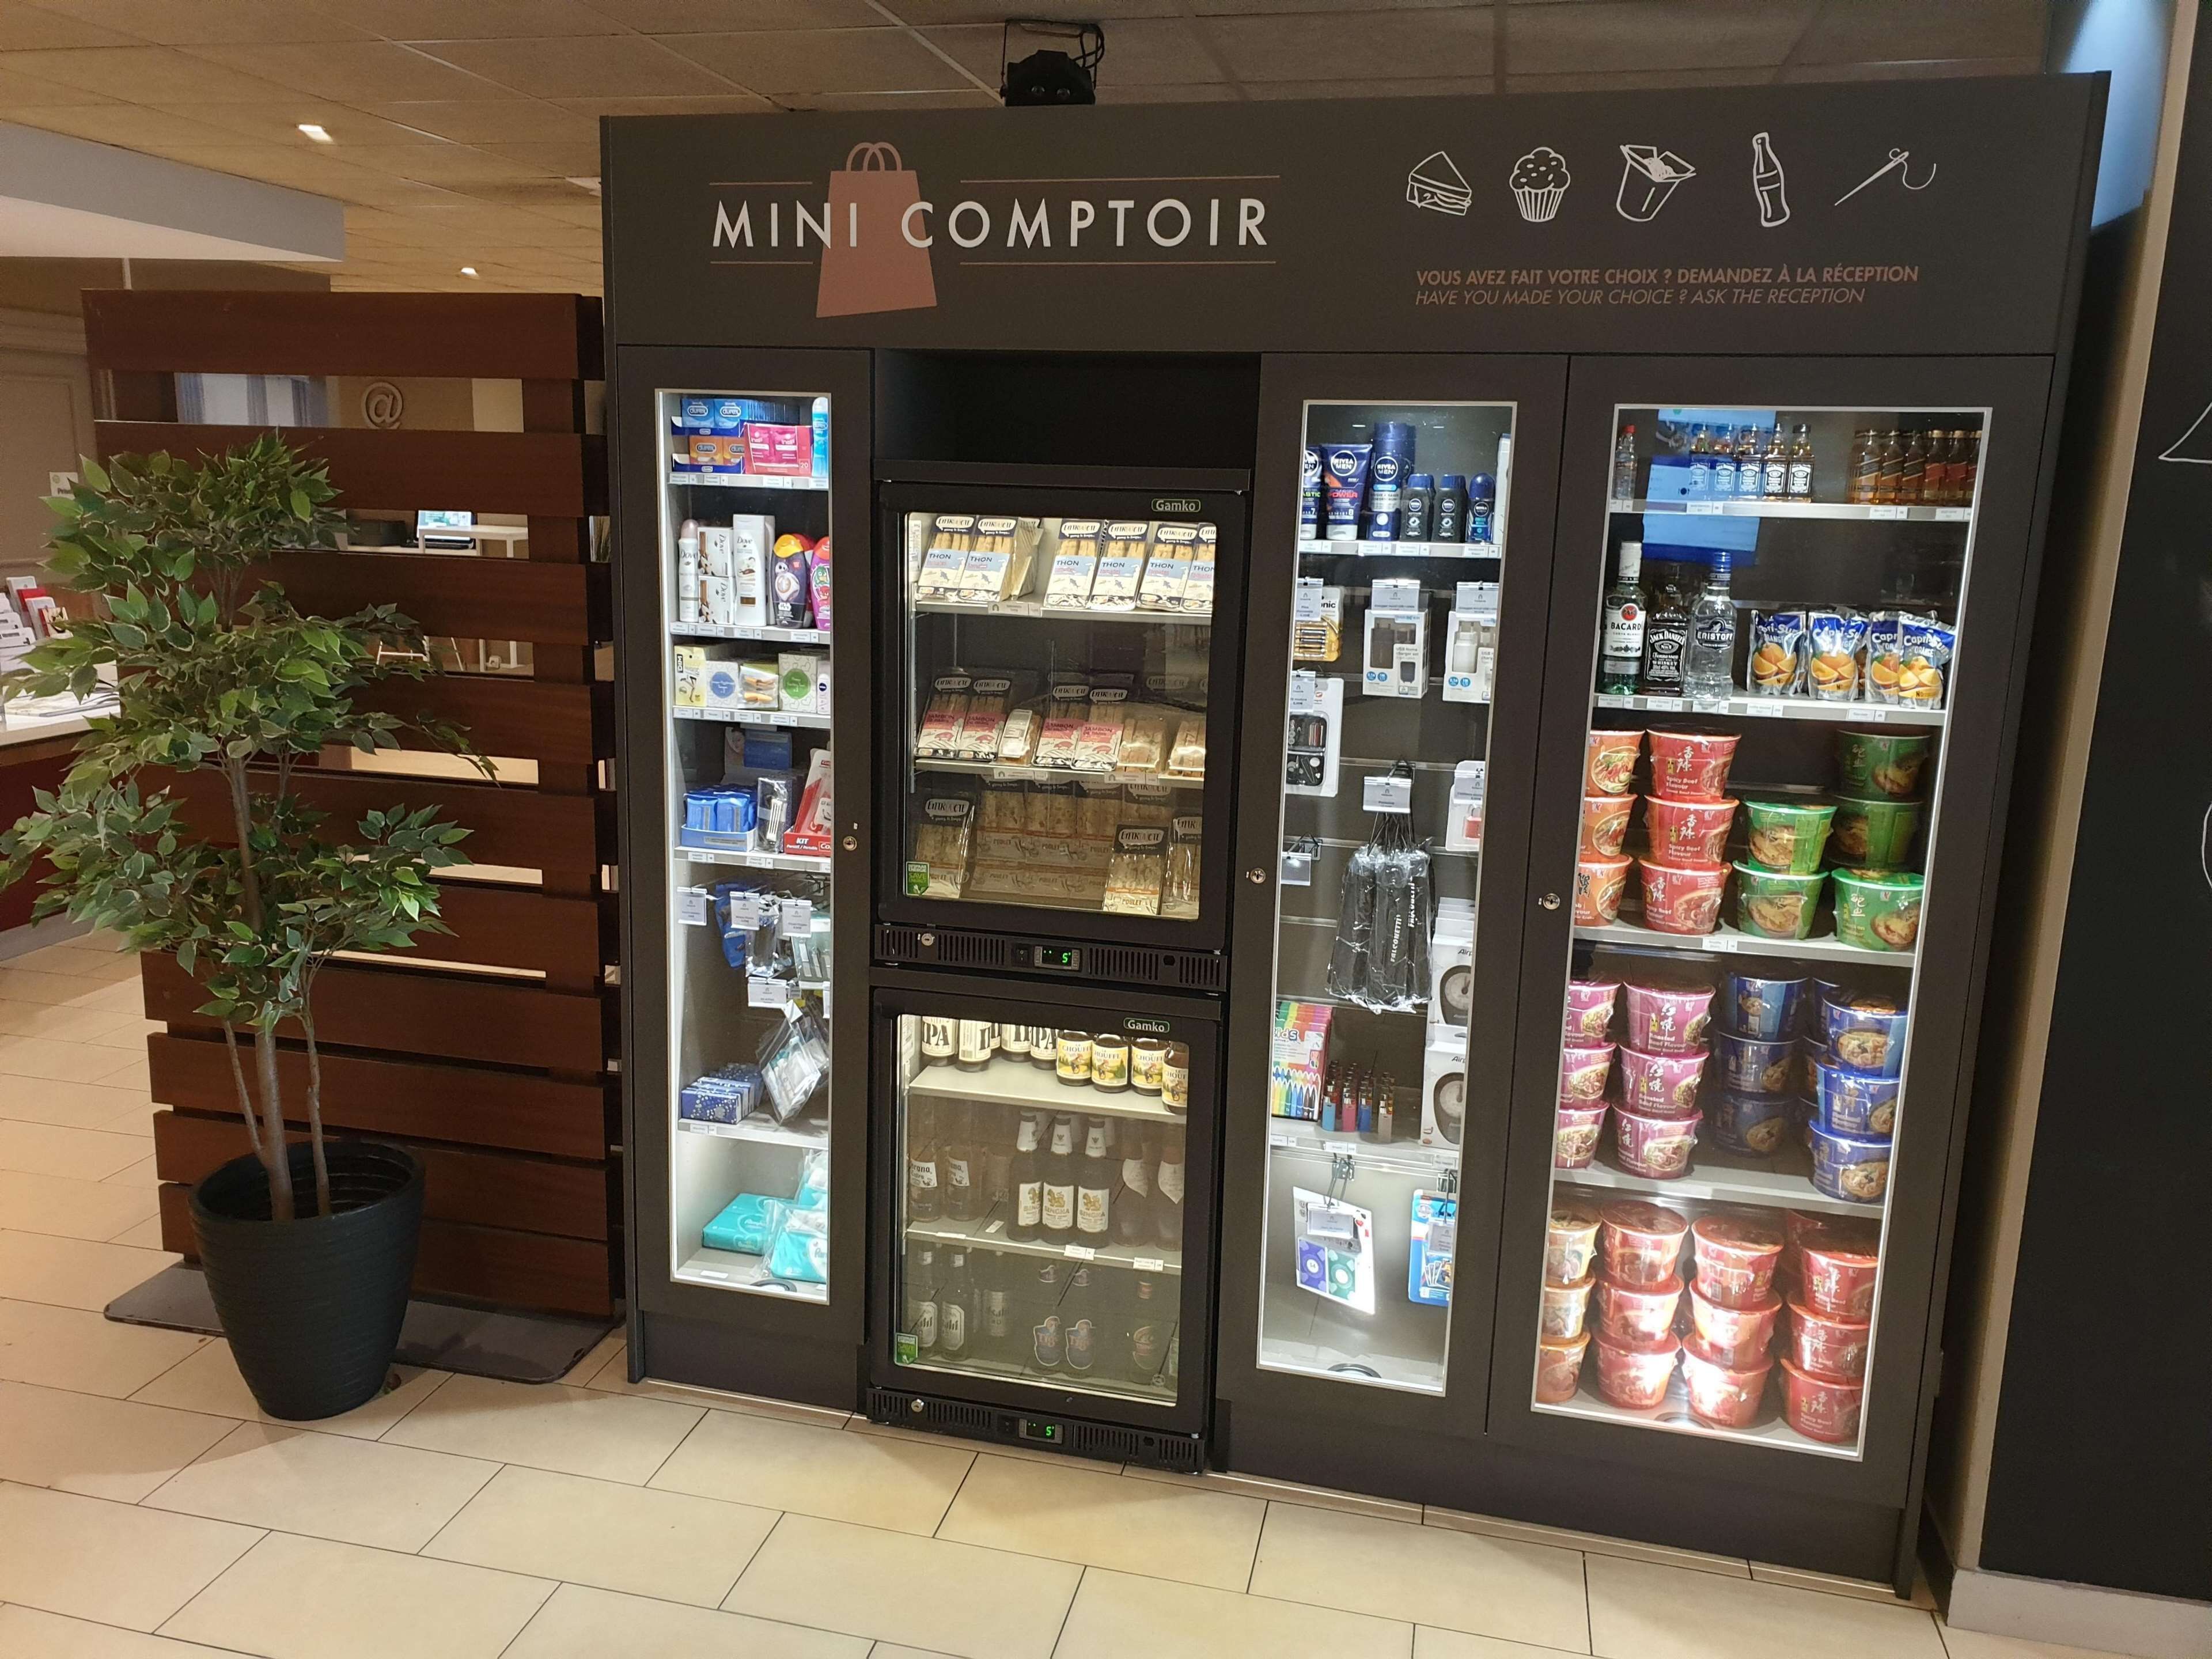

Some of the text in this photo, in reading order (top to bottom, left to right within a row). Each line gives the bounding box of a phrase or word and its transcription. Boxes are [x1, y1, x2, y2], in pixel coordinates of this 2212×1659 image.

[713, 198, 1267, 249] MINI COMPTOIR
[1416, 263, 1919, 286] VOUS AVEZ FAIT VOTRE CHOIX ? DEMANDEZ À LA RÉCEPTION
[1416, 287, 1865, 305] HAVE YOU MADE YOUR CHOICE ? ASK THE RECEPTION
[1156, 499, 1196, 512] Gamko
[718, 534, 727, 554] Dove
[680, 550, 698, 559] Dove
[720, 581, 729, 602] Dove
[1649, 632, 1664, 644] JACK
[1872, 632, 1898, 643] Capr
[1914, 646, 1934, 658] ORANGE
[1389, 914, 1402, 963] FALCONETTI
[1127, 1020, 1165, 1033] Gamko
